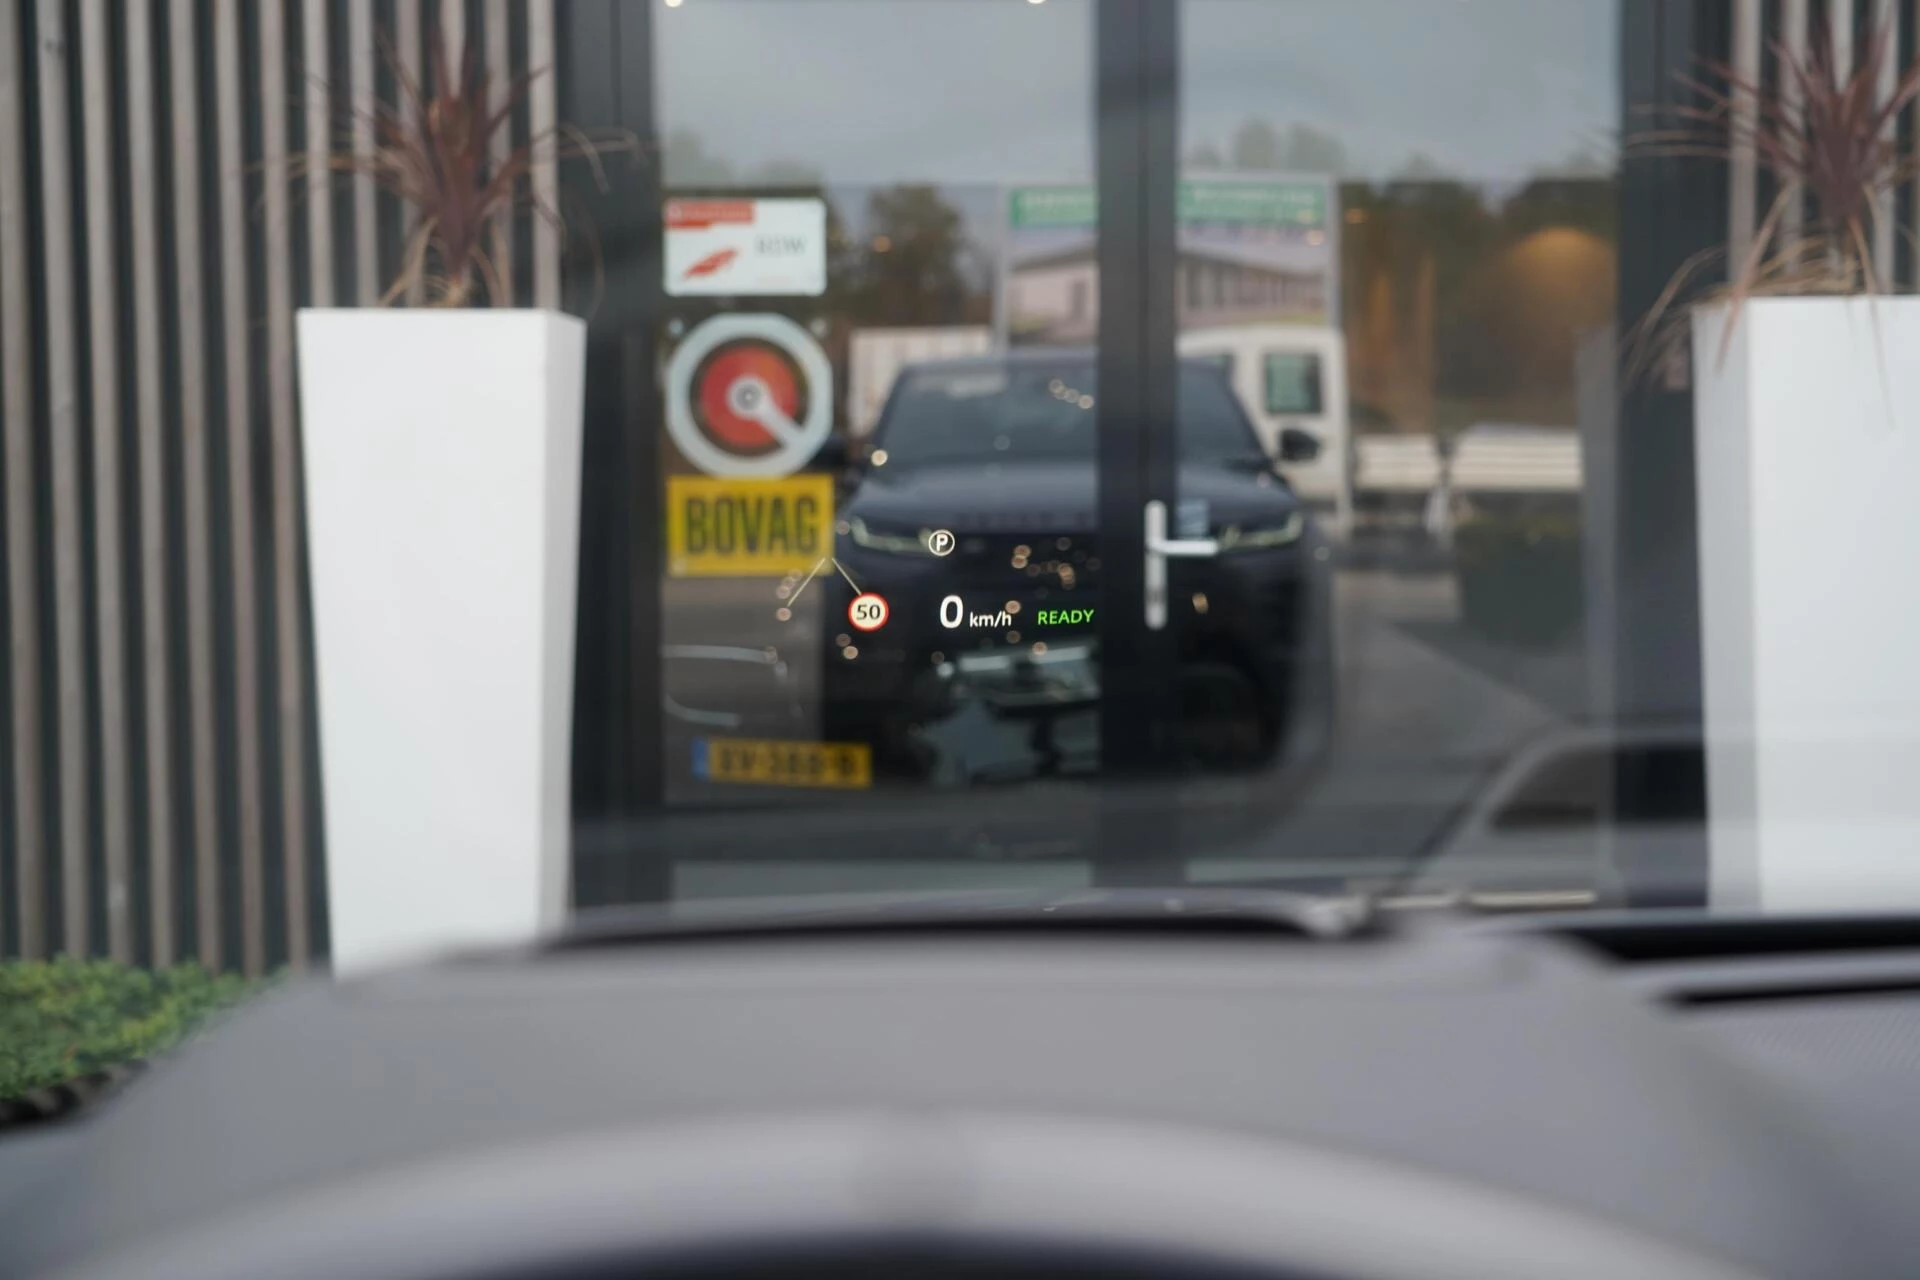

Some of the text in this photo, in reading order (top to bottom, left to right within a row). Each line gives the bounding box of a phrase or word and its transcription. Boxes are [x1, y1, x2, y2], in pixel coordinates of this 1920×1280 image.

[687, 495, 818, 554] BOVAG
[935, 534, 949, 552] P
[856, 604, 881, 620] 50
[939, 594, 1012, 629] 0 km/h
[1037, 609, 1095, 625] READY
